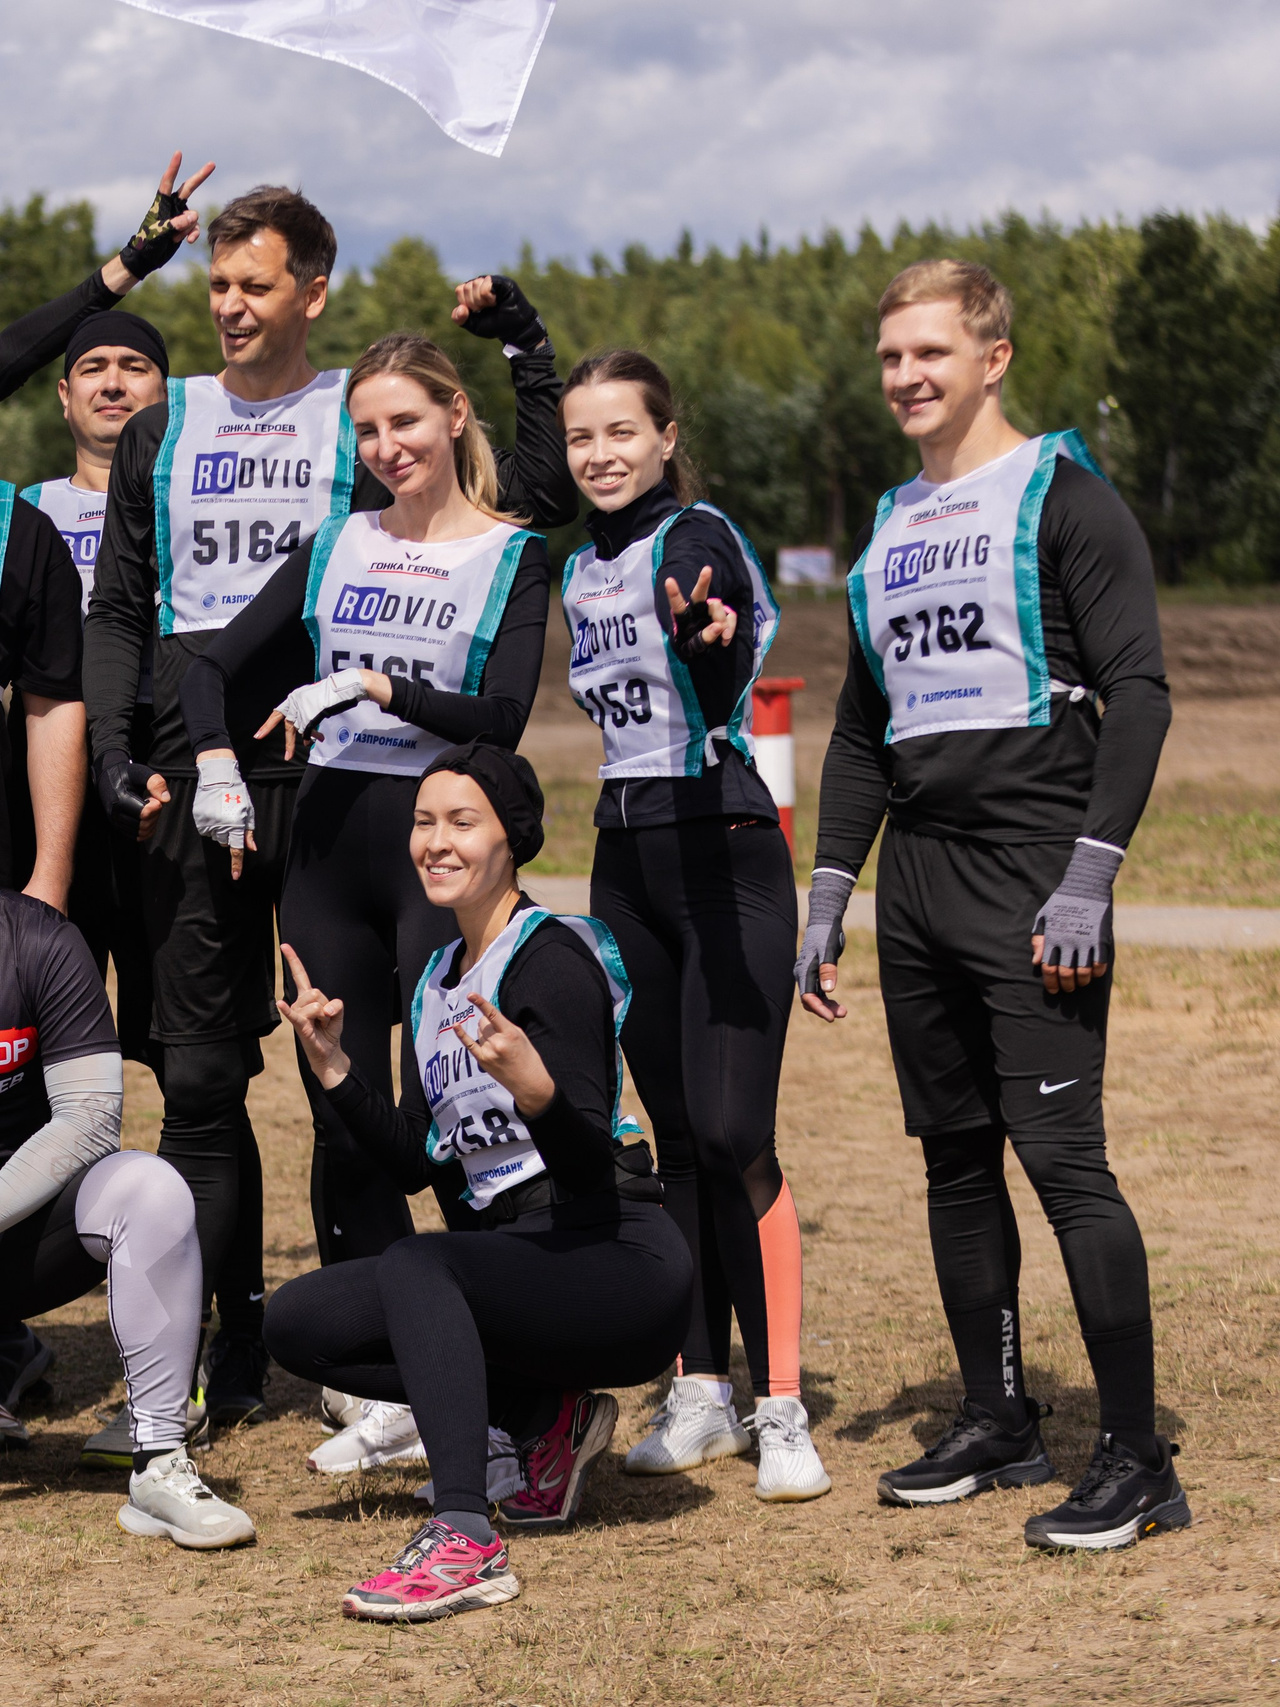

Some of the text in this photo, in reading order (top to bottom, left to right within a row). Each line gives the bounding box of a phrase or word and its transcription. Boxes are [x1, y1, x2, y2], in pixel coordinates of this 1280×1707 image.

[218, 424, 296, 434] ГОНКА ГЕРОЕВ
[196, 457, 312, 491] RODVIG
[79, 510, 106, 520] ГОНК
[908, 500, 978, 524] ГОНКА ГЕРОЕВ
[193, 520, 301, 565] 5164
[370, 562, 450, 578] ГОНКА ГЕРОЕВ
[887, 534, 991, 585] RODVIG
[222, 594, 254, 604] ГАЗПРО
[579, 591, 602, 600] ГОНКА
[337, 590, 457, 630] RODVIG
[572, 613, 638, 662] RODVIG
[888, 602, 992, 662] 5162
[921, 686, 982, 704] ГАЗПРОМБАНК
[354, 732, 417, 750] ГАЗПРОМБАНК
[438, 1018, 450, 1031] НКА
[472, 1161, 524, 1182] ГАЗПРОМБАНК
[1000, 1308, 1015, 1398] ATHLEX
